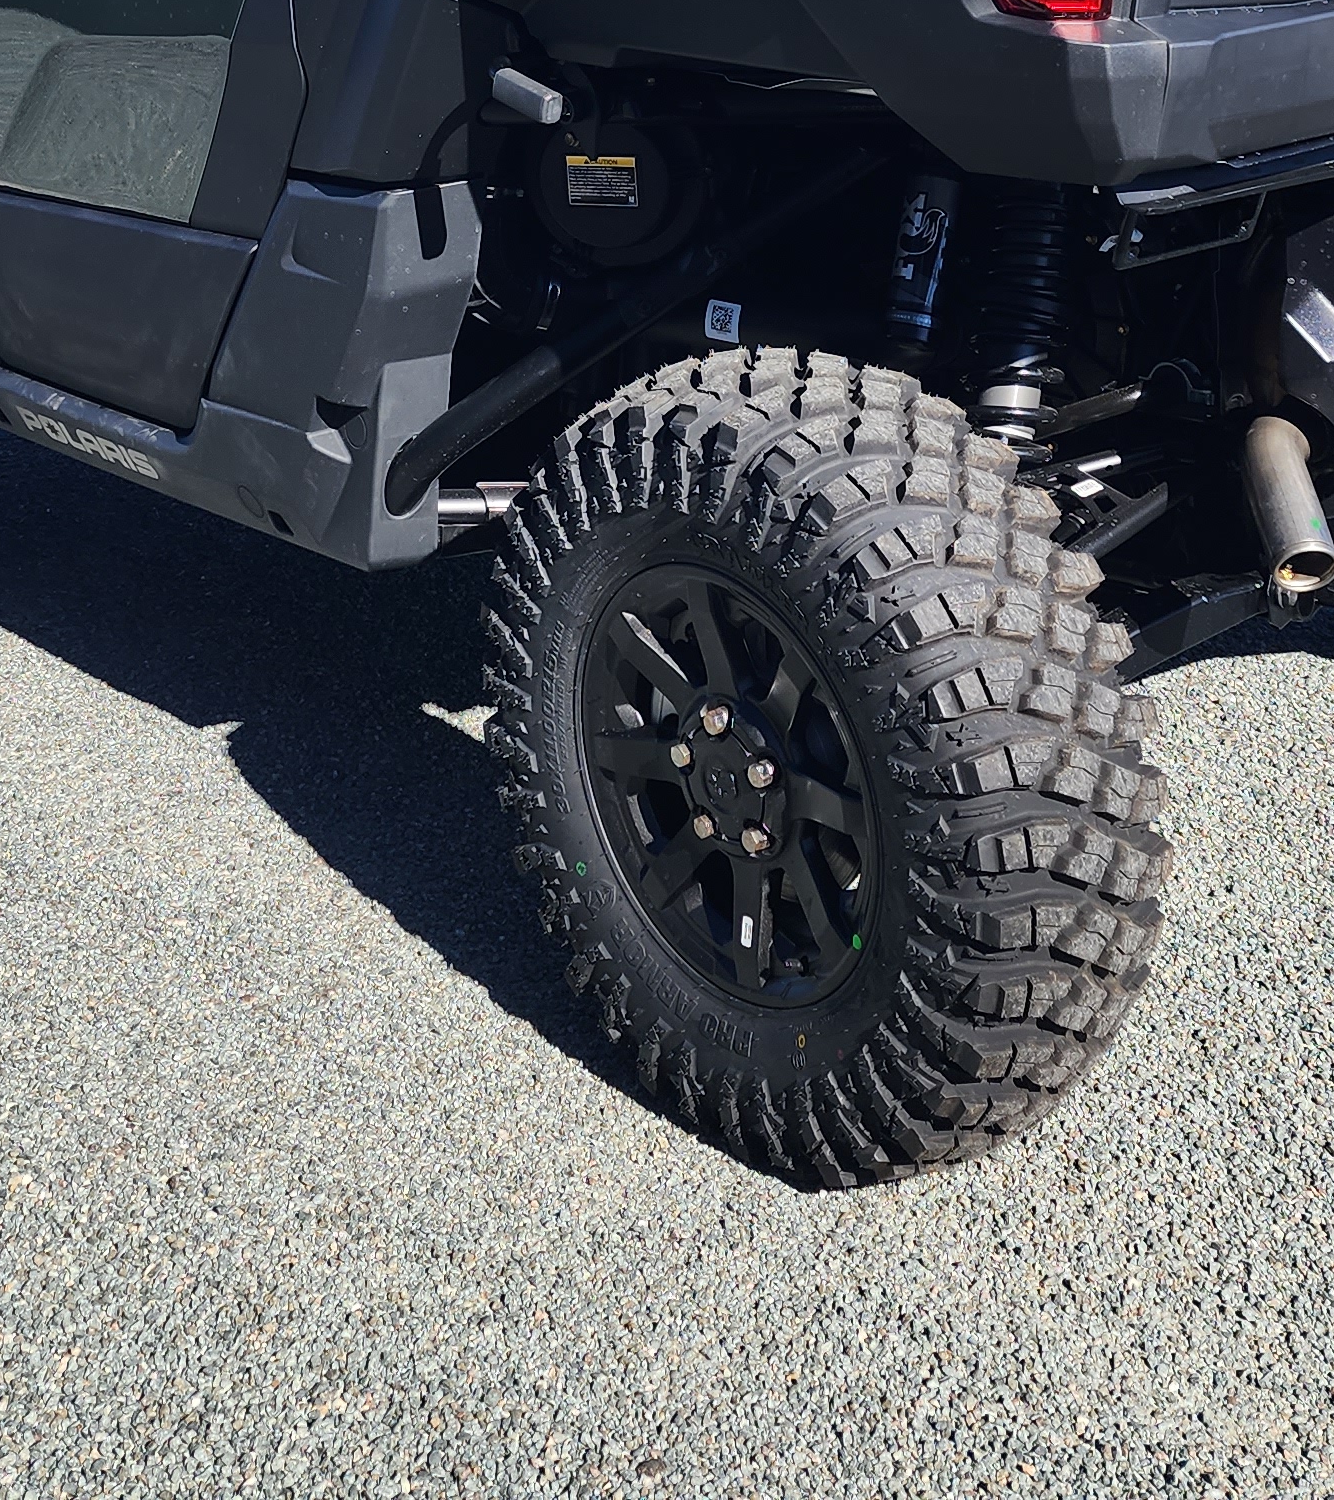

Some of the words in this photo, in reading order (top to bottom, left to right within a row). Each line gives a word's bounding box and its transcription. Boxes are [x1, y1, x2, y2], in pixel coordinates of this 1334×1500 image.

[16, 405, 160, 480] POLARIS
[610, 916, 699, 1023] ARMOR
[699, 1011, 754, 1058] PRO
